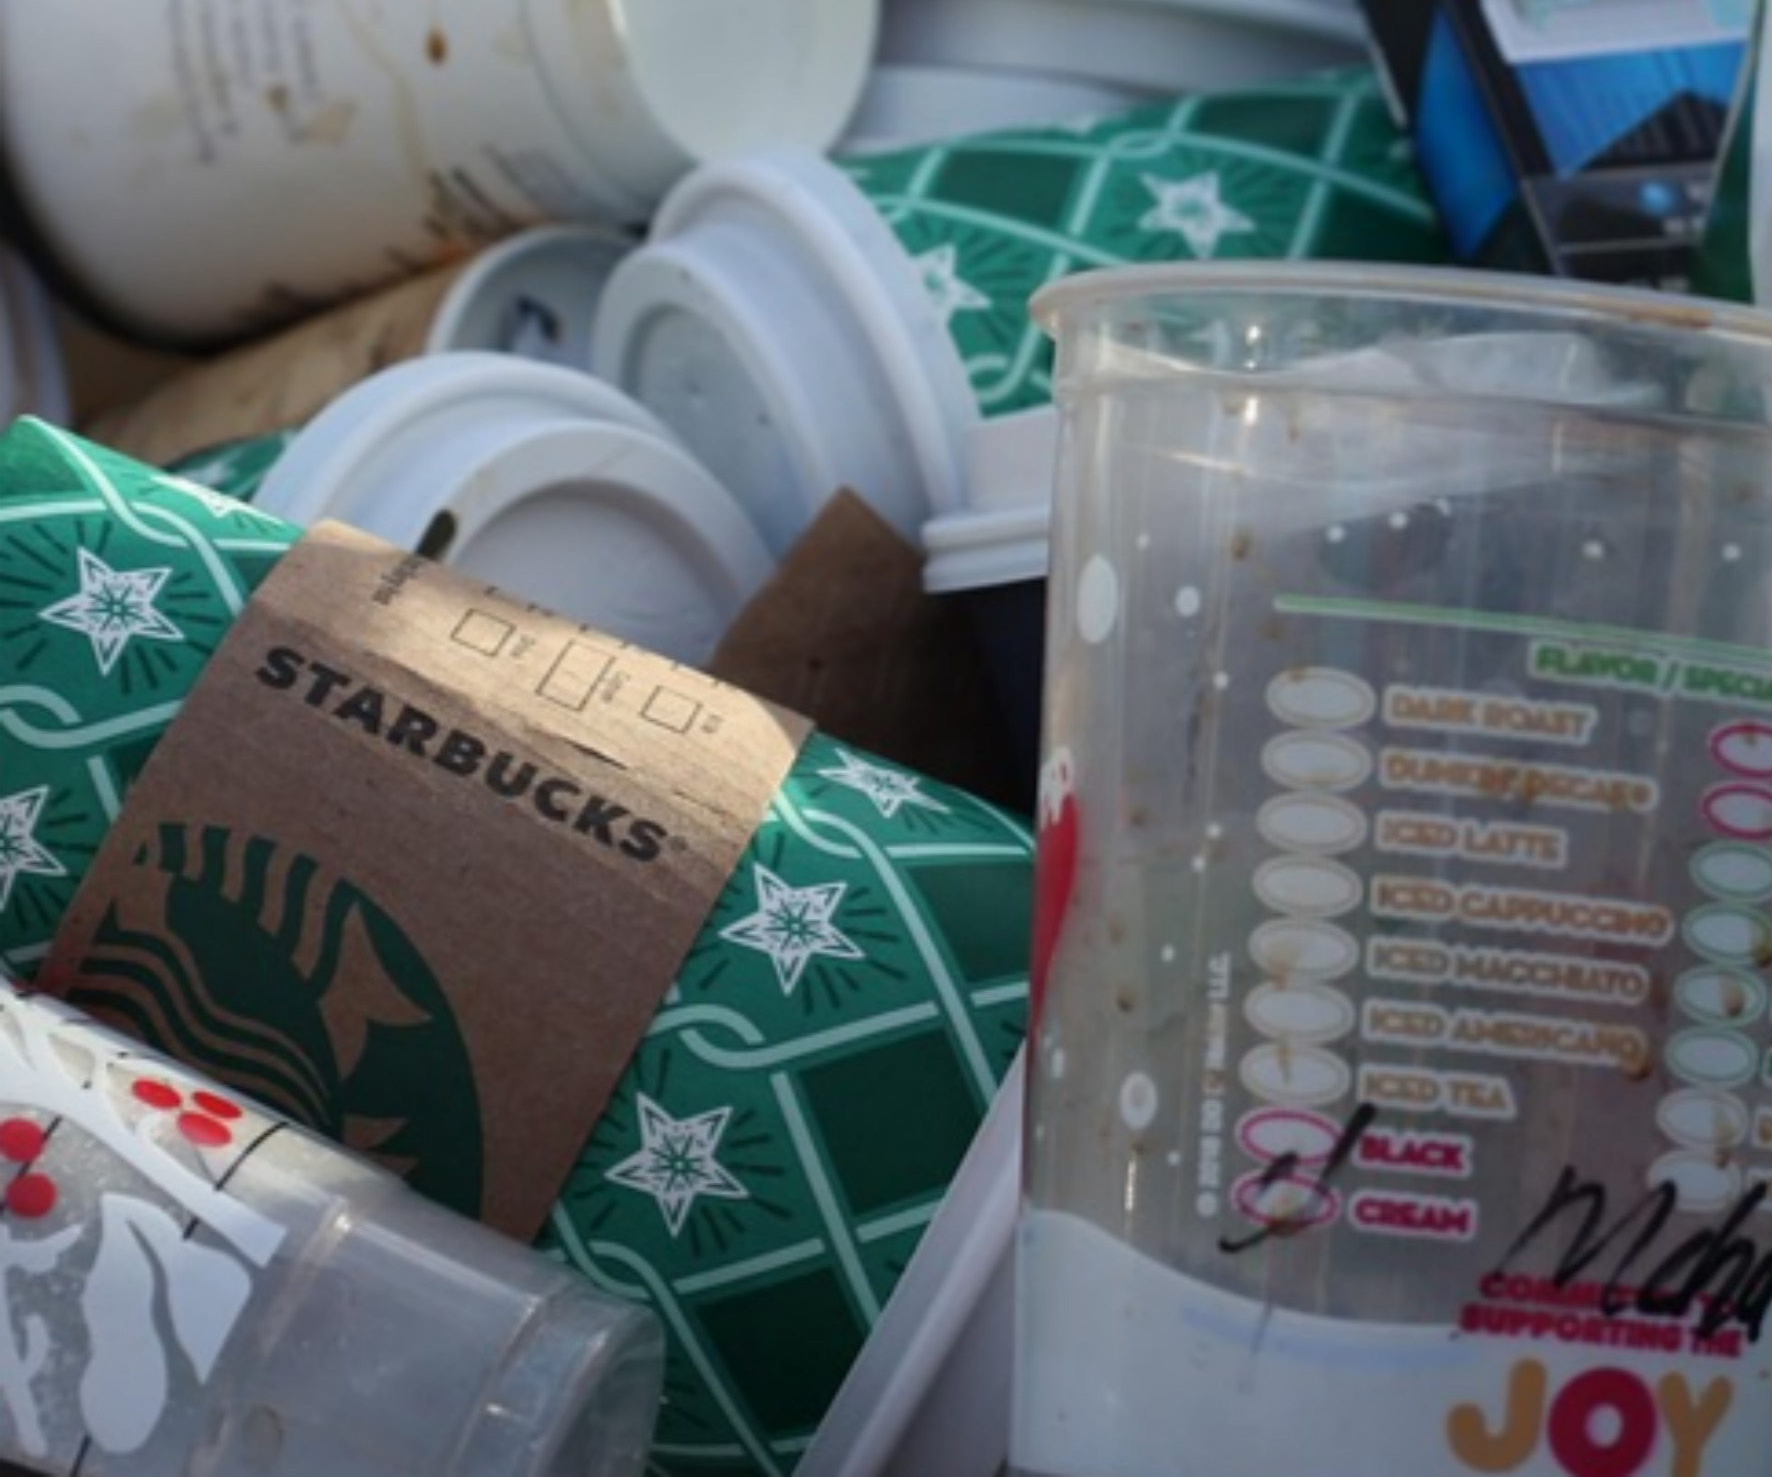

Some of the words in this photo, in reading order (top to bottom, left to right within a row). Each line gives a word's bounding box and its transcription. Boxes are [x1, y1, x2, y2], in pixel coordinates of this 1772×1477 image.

[1535, 644, 1659, 683] FLAVOR
[1388, 691, 1472, 728] DARK
[1482, 698, 1593, 737] ROAST
[256, 644, 668, 866] STARBUCKS
[1380, 816, 1459, 851] ICED
[1462, 822, 1562, 864] LATTE
[1375, 881, 1455, 914] ICED
[1371, 944, 1451, 977] ICED
[1455, 950, 1645, 999] MACCHIATO
[1367, 1007, 1447, 1039] ICED
[1451, 1013, 1645, 1067] AMERICANO
[1362, 1073, 1442, 1105] ICED
[1452, 1078, 1511, 1112] TEA
[1359, 1134, 1465, 1172] BLACK
[1354, 1197, 1473, 1236] CREAM
[1460, 1302, 1683, 1353] SUPPORTING
[1445, 1357, 1732, 1477] JOY
